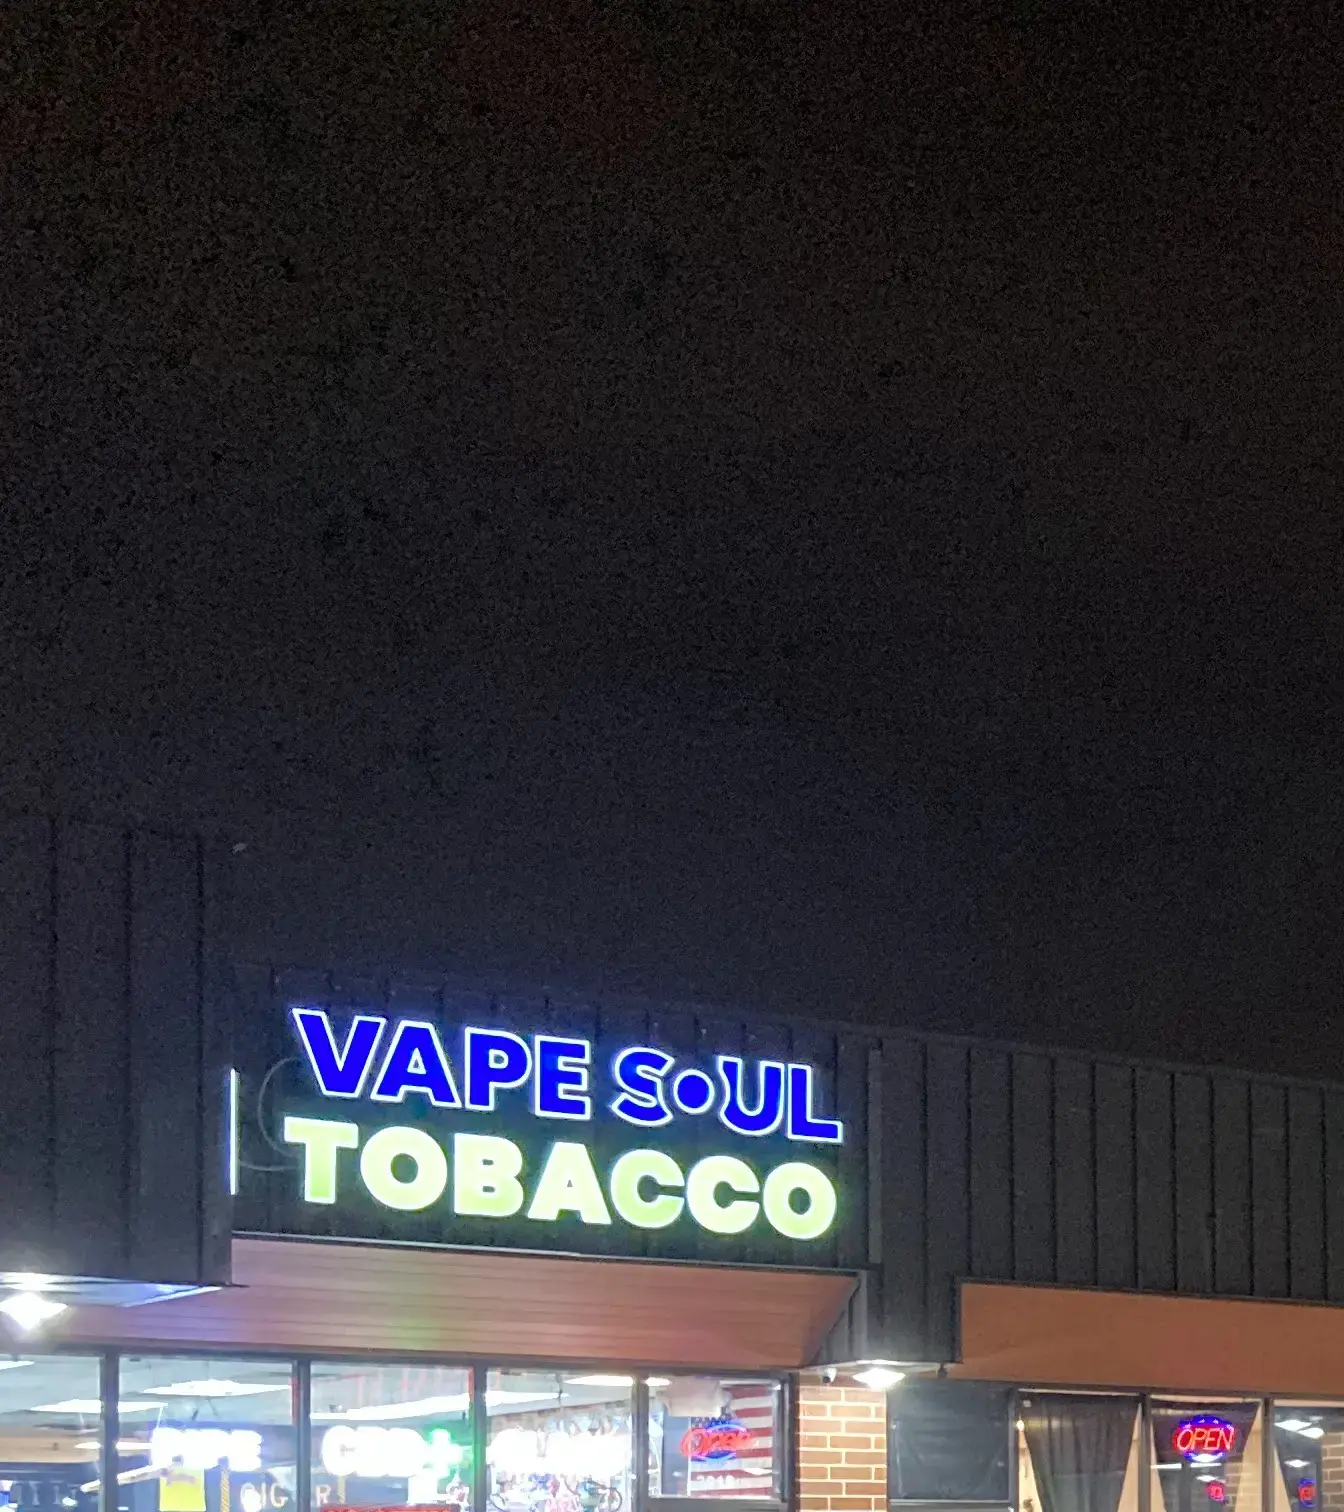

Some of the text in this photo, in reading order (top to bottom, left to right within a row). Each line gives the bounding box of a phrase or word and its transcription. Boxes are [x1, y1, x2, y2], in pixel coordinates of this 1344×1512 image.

[292, 1006, 843, 1144] VAPE SOUL
[284, 1117, 838, 1240] TOBACCO
[1176, 1427, 1235, 1452] OPEN
